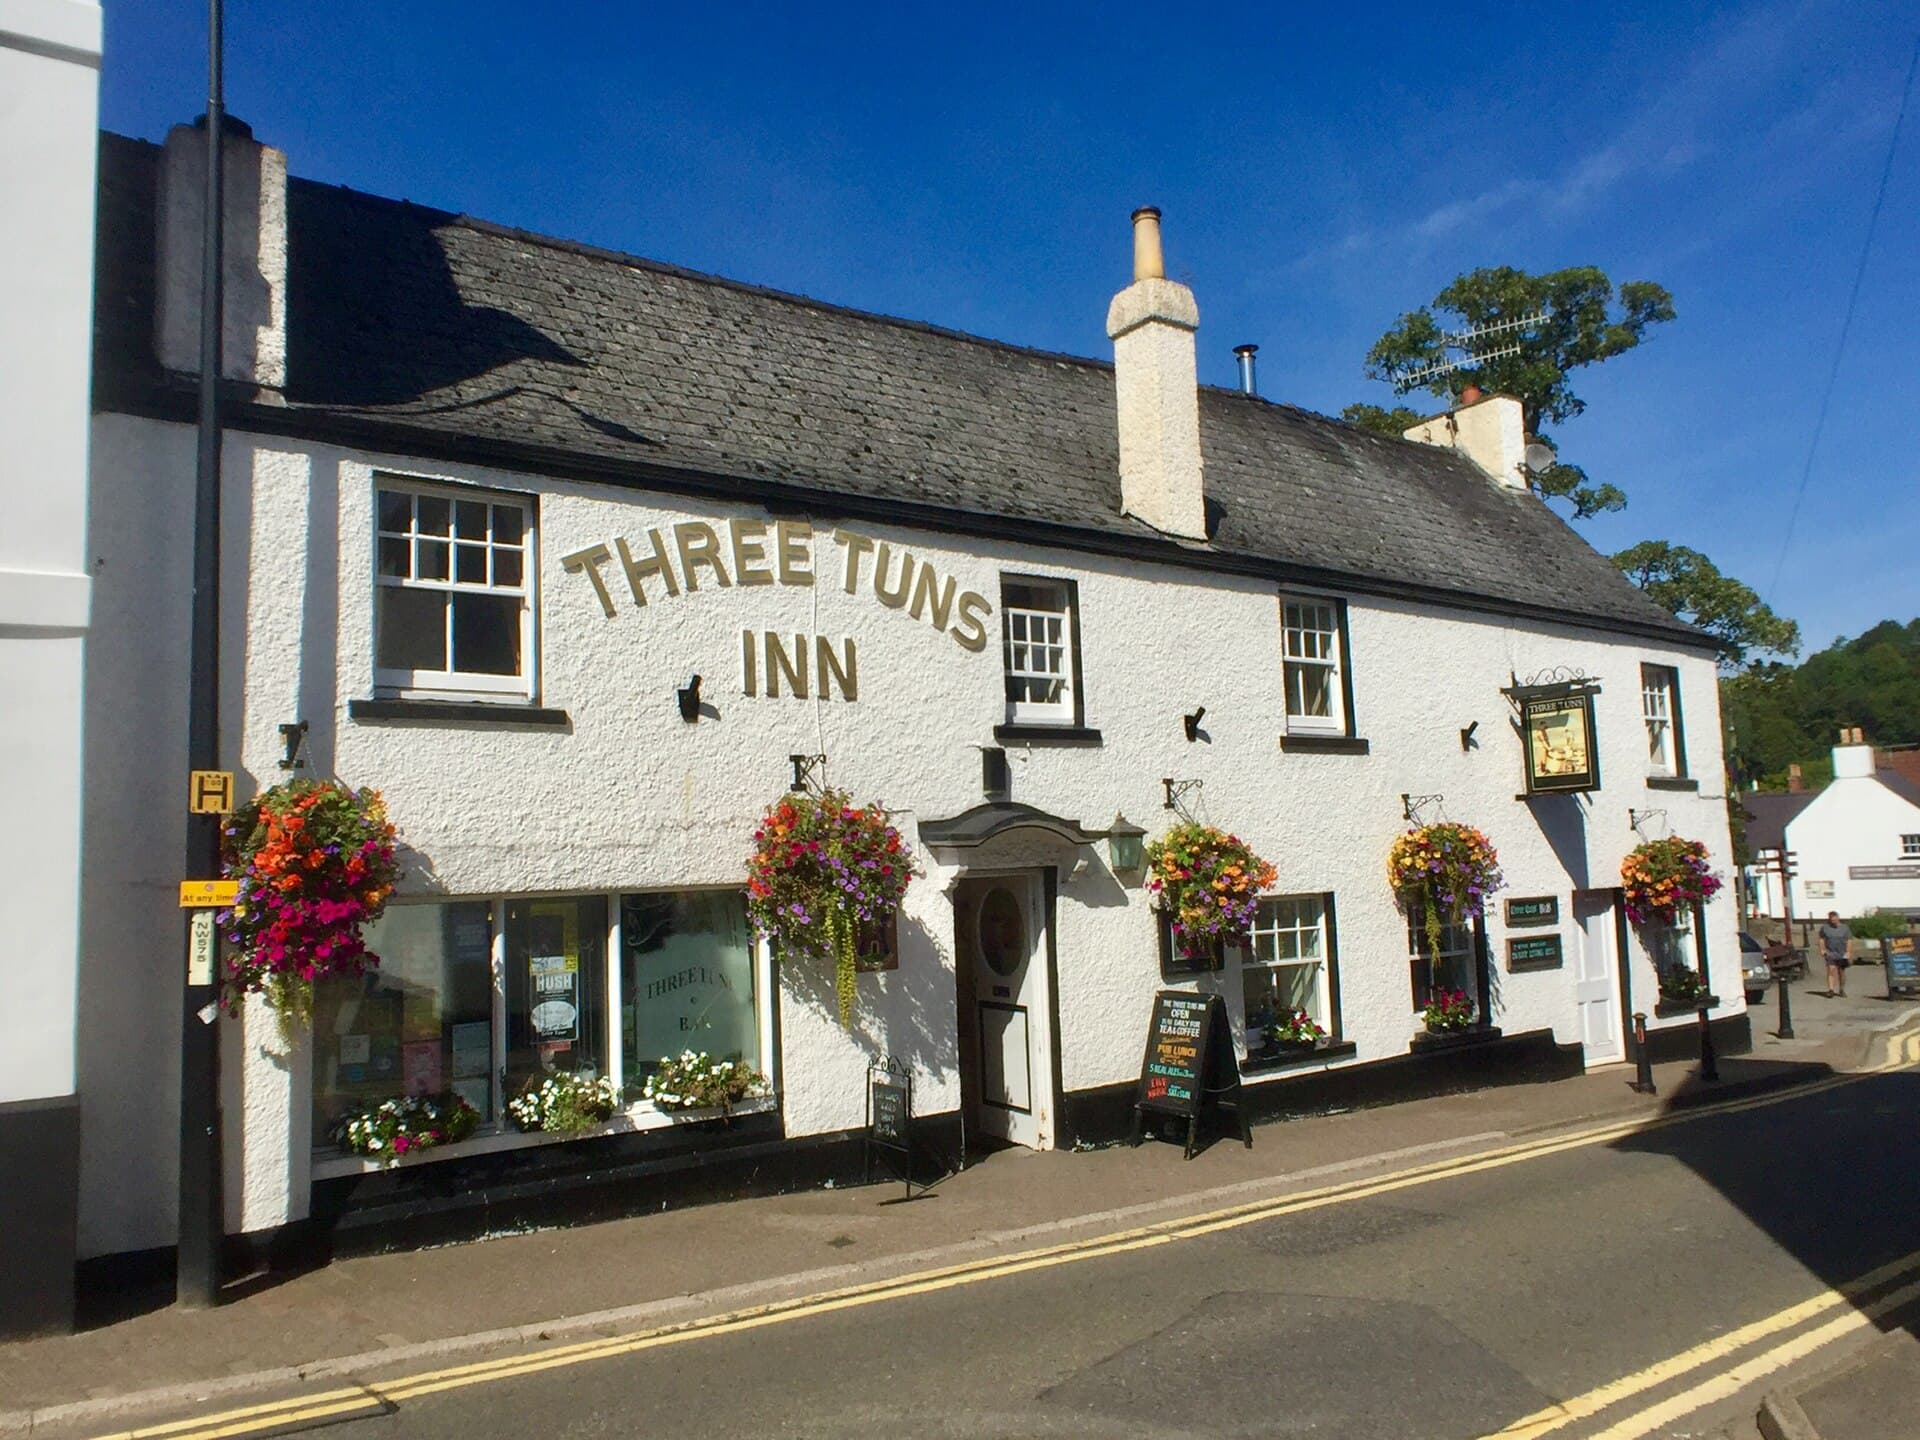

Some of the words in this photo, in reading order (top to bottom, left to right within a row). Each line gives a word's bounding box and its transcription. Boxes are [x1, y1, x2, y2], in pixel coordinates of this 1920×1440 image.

[561, 518, 816, 619] THREE
[833, 528, 993, 653] TUNS
[743, 629, 858, 702] INN
[1529, 703, 1557, 713] THREE
[1558, 698, 1584, 710] TUNS
[198, 775, 227, 810] H
[196, 895, 212, 903] any
[647, 966, 698, 999] THREE
[1171, 1009, 1190, 1019] OPEN
